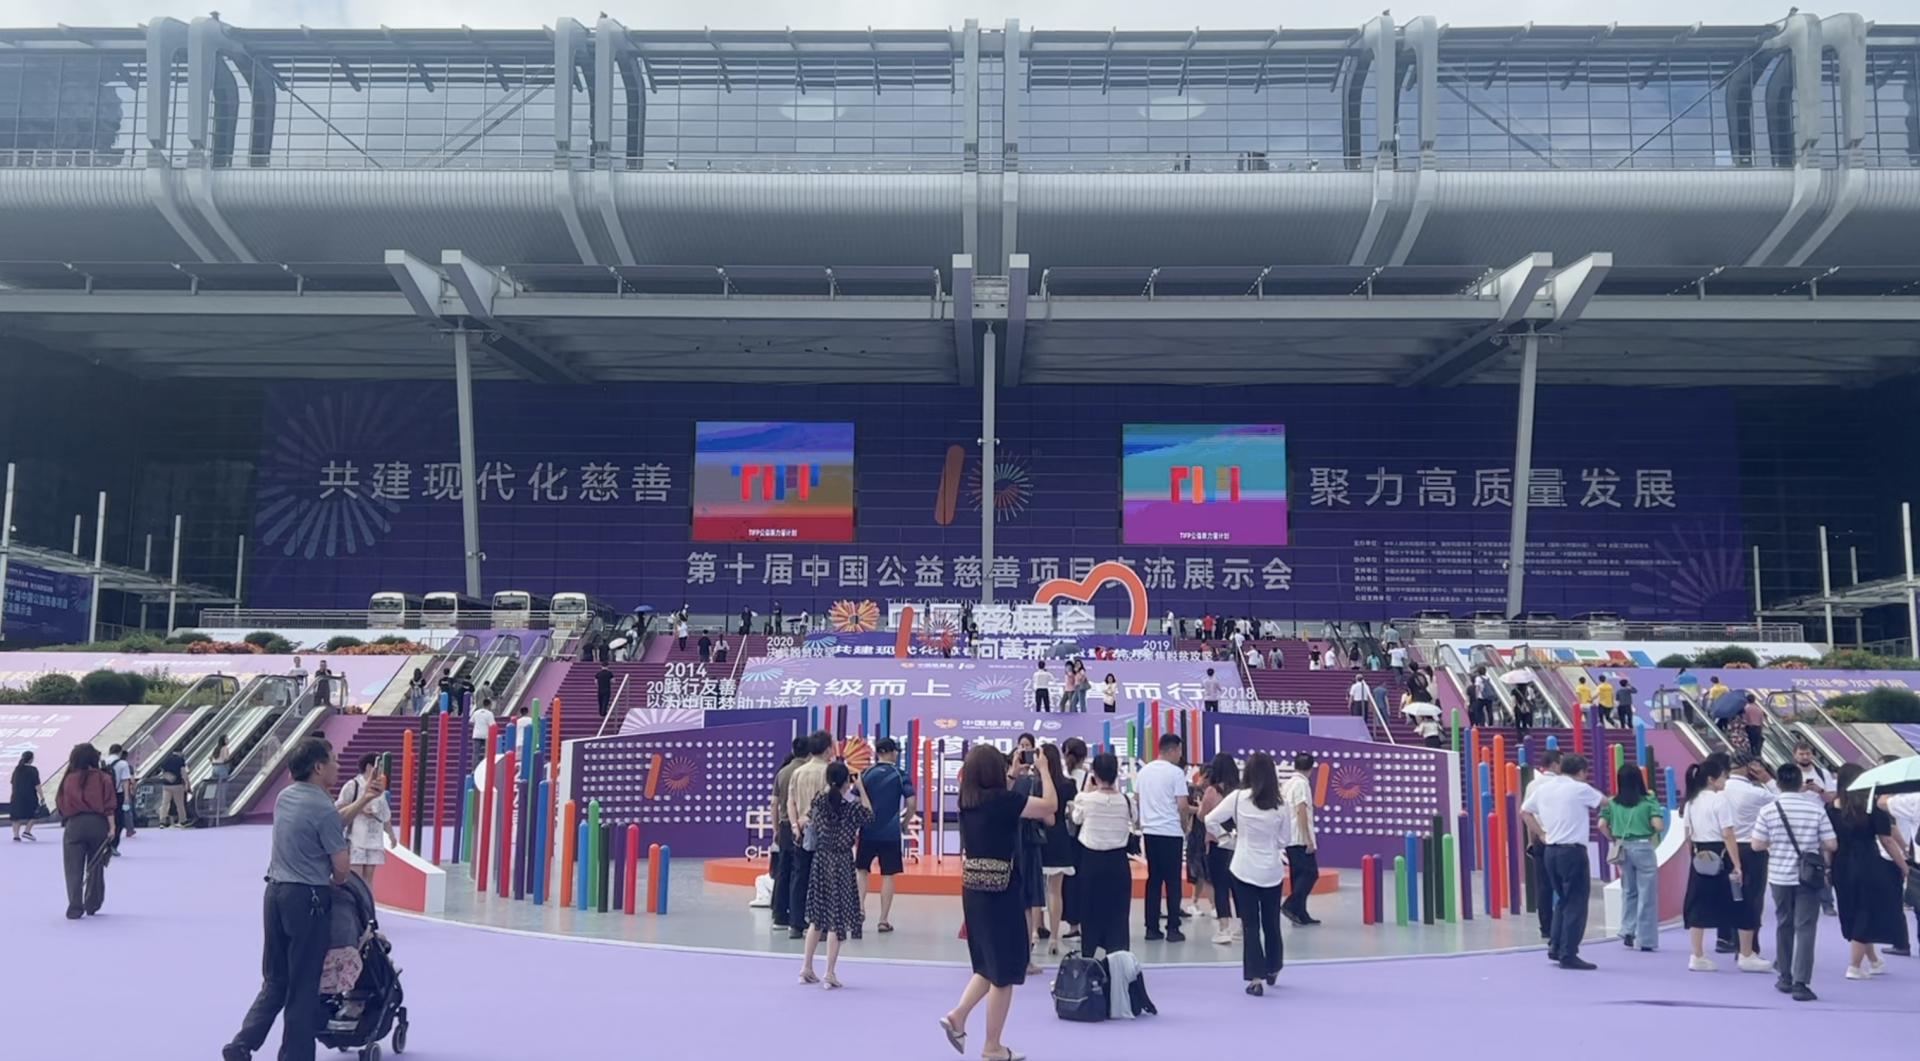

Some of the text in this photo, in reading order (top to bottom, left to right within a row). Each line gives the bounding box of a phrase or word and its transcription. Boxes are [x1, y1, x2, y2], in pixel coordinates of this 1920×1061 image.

[319, 461, 671, 501] 共建现代化慈善
[1310, 467, 1676, 508] 聚力高质量发展
[767, 636, 794, 647] 2020
[1143, 640, 1171, 651] 2019
[664, 662, 707, 678] 2014
[779, 678, 952, 697] 拾级而上
[1220, 686, 1255, 699] 2018
